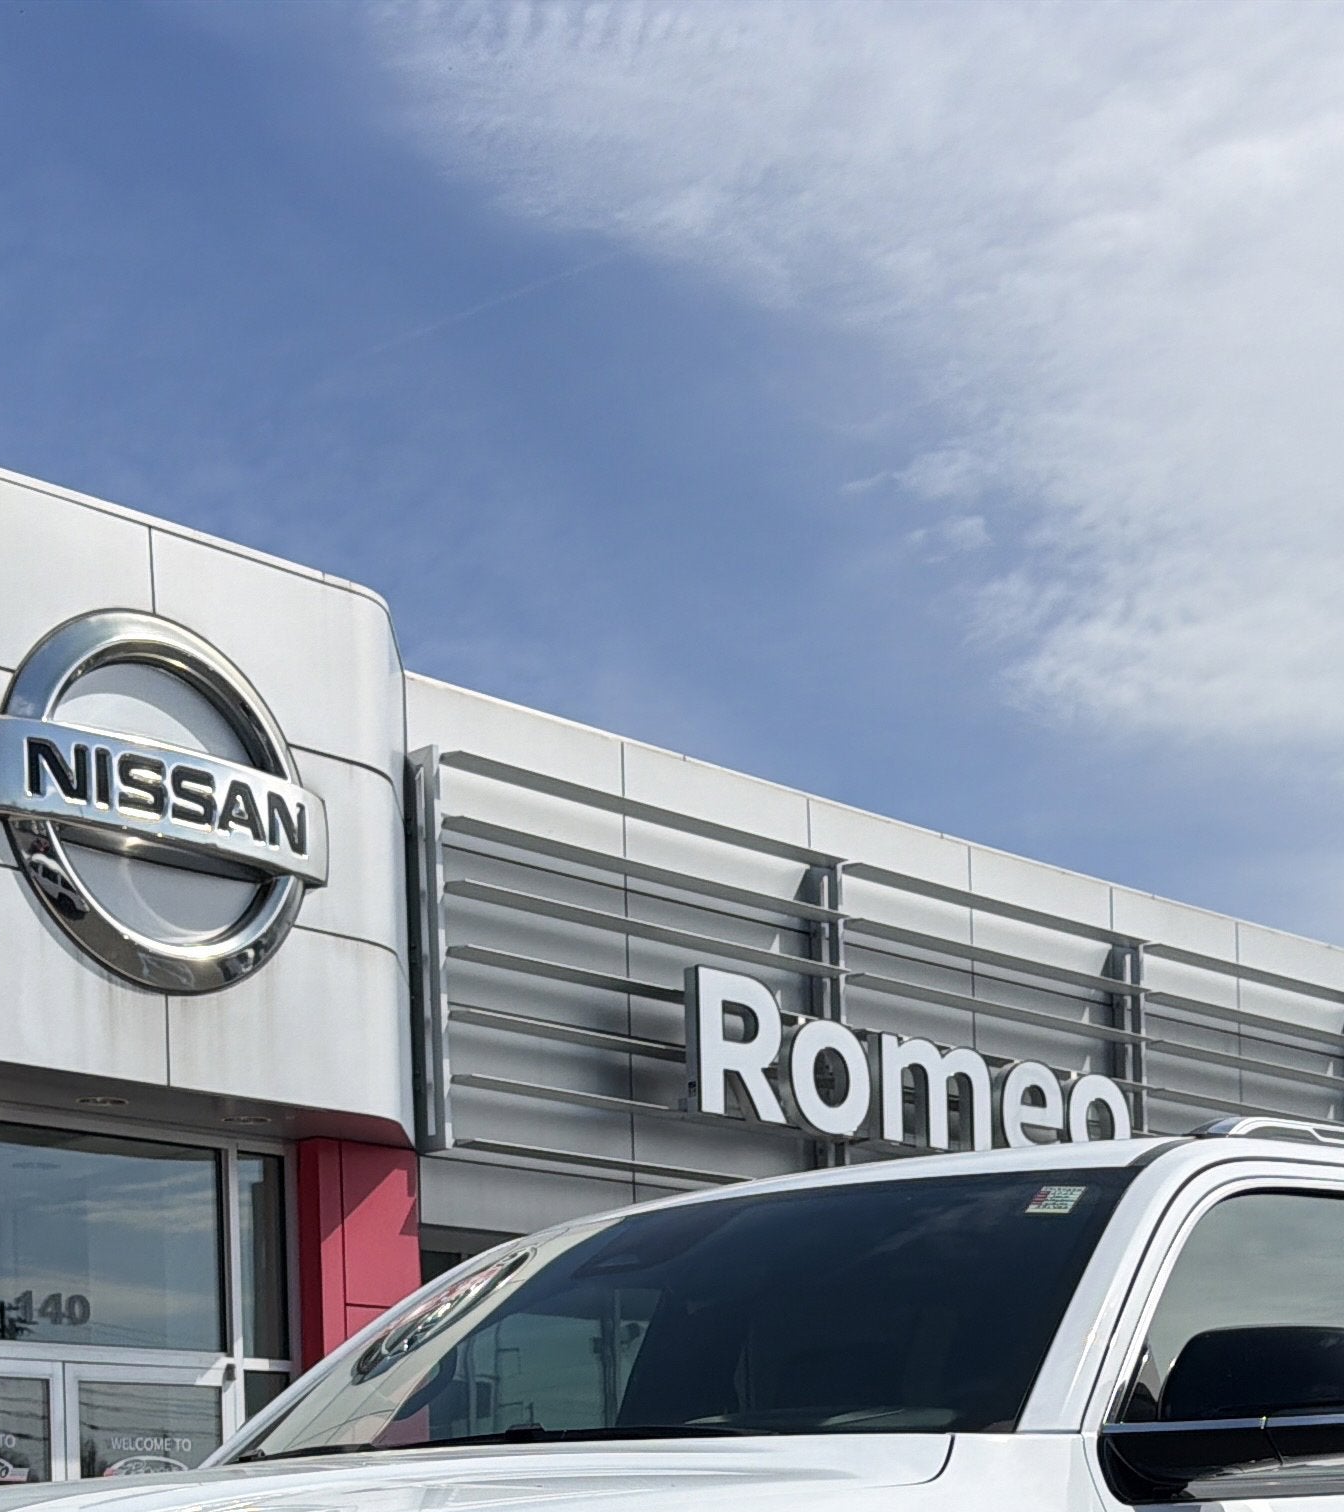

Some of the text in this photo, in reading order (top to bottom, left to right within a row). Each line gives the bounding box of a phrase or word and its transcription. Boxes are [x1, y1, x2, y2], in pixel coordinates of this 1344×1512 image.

[24, 736, 309, 859] NISSAN
[688, 964, 1131, 1152] Romeo
[14, 1290, 90, 1325] 140
[111, 1437, 192, 1452] WELCOME TO
